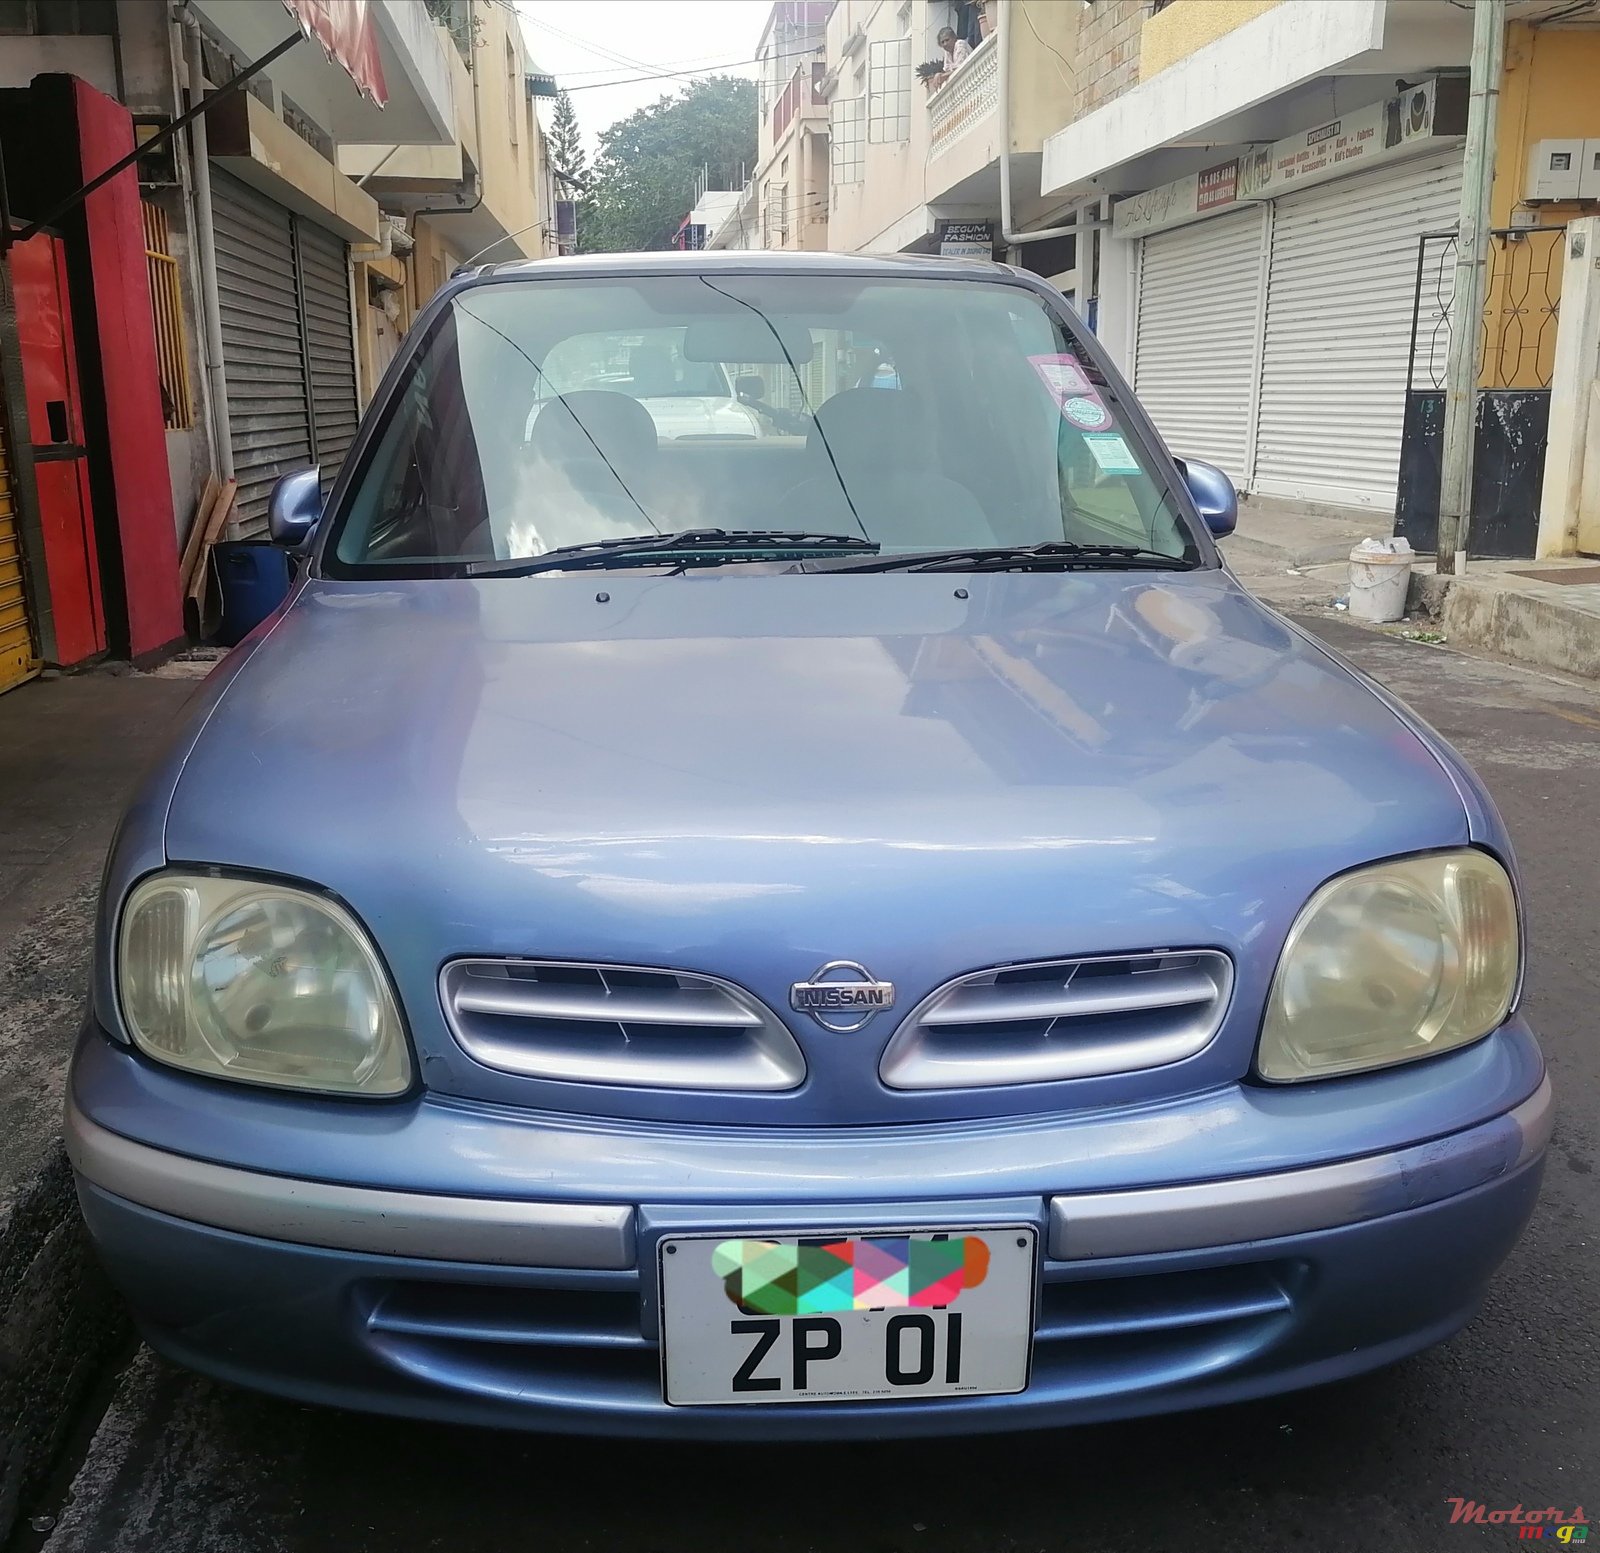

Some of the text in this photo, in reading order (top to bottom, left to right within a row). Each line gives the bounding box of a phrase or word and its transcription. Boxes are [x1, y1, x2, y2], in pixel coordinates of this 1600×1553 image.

[1308, 125, 1334, 145] SPECIALIST
[1356, 127, 1374, 142] Fabrics
[1301, 157, 1327, 173] Accessories
[1346, 145, 1364, 158] Clothes
[944, 233, 990, 241] FASHION
[947, 225, 986, 233] BEGUM
[804, 989, 883, 1006] NISSAN
[731, 1317, 842, 1392] ZP
